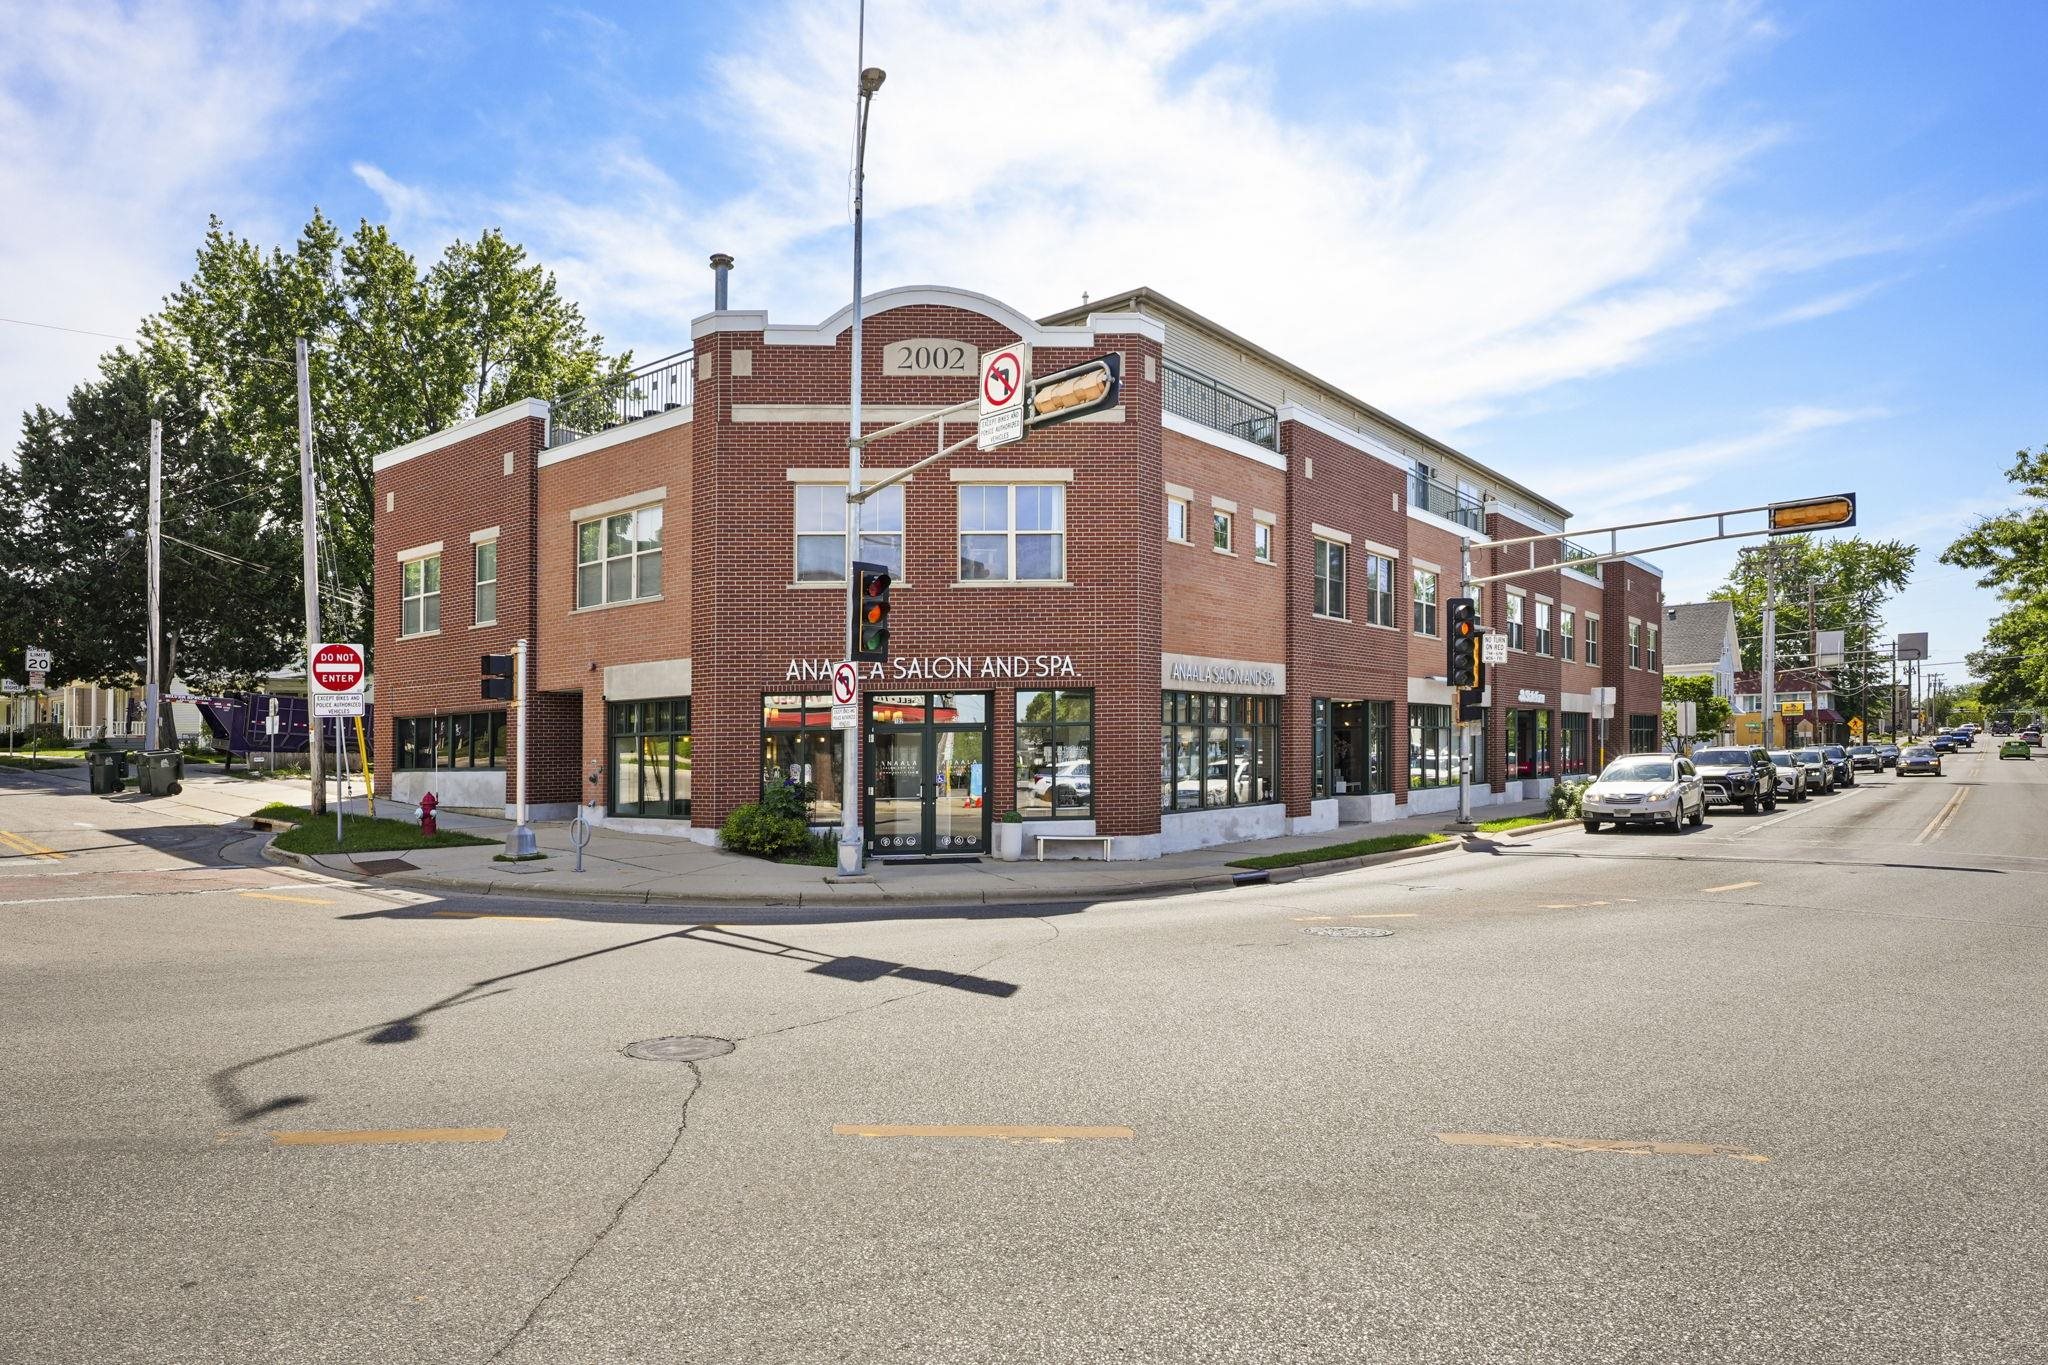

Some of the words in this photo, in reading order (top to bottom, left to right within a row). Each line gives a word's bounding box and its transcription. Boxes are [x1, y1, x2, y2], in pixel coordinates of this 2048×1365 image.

[897, 346, 965, 371] 2002
[28, 658, 48, 669] 20
[320, 653, 334, 662] DO
[336, 653, 354, 662] NOT
[786, 658, 885, 681] ANAA
[893, 656, 972, 680] SALON
[980, 656, 1030, 678] AND
[1172, 662, 1212, 682] ANAALA
[1213, 666, 1243, 685] SALON
[322, 674, 354, 683] ENTER
